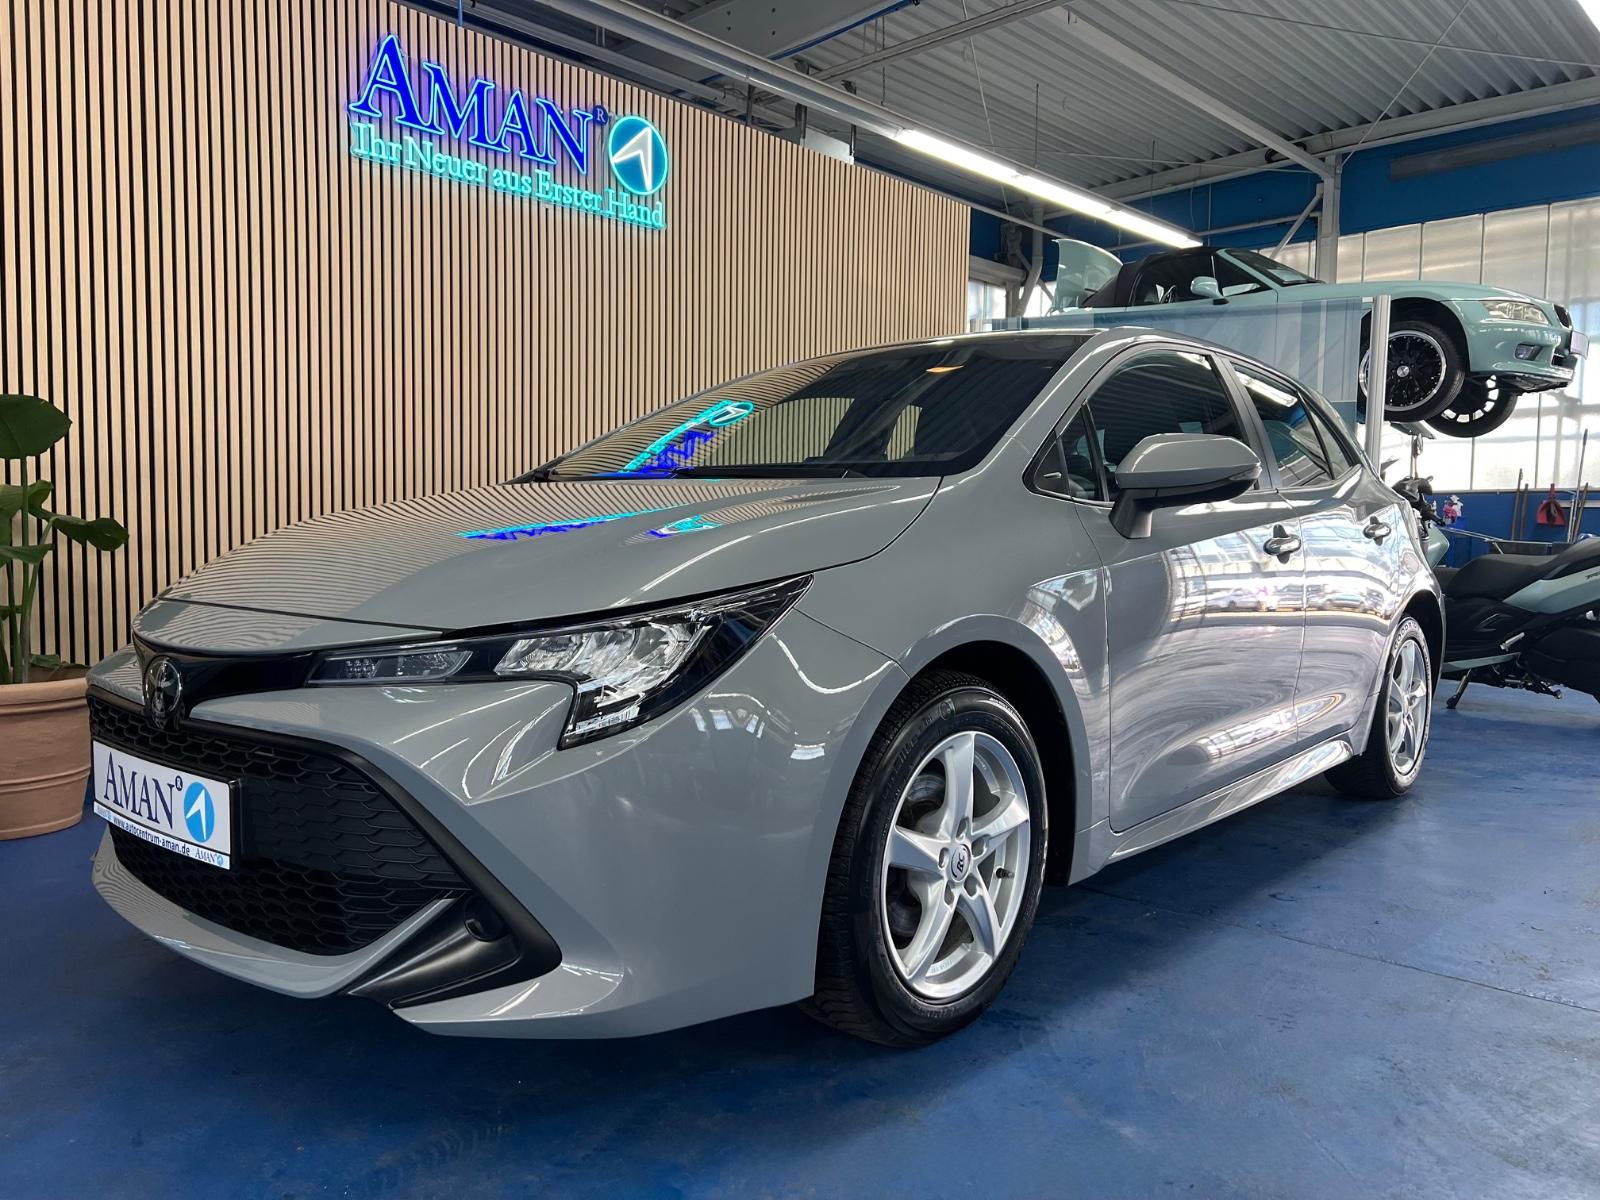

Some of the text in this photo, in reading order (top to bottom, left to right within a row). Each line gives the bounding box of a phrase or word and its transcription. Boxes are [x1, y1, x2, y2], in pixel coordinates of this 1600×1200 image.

[351, 121, 666, 229] Ihr Neuer aus Erster Hand
[113, 815, 191, 857] www.autocentrum-aman.de
